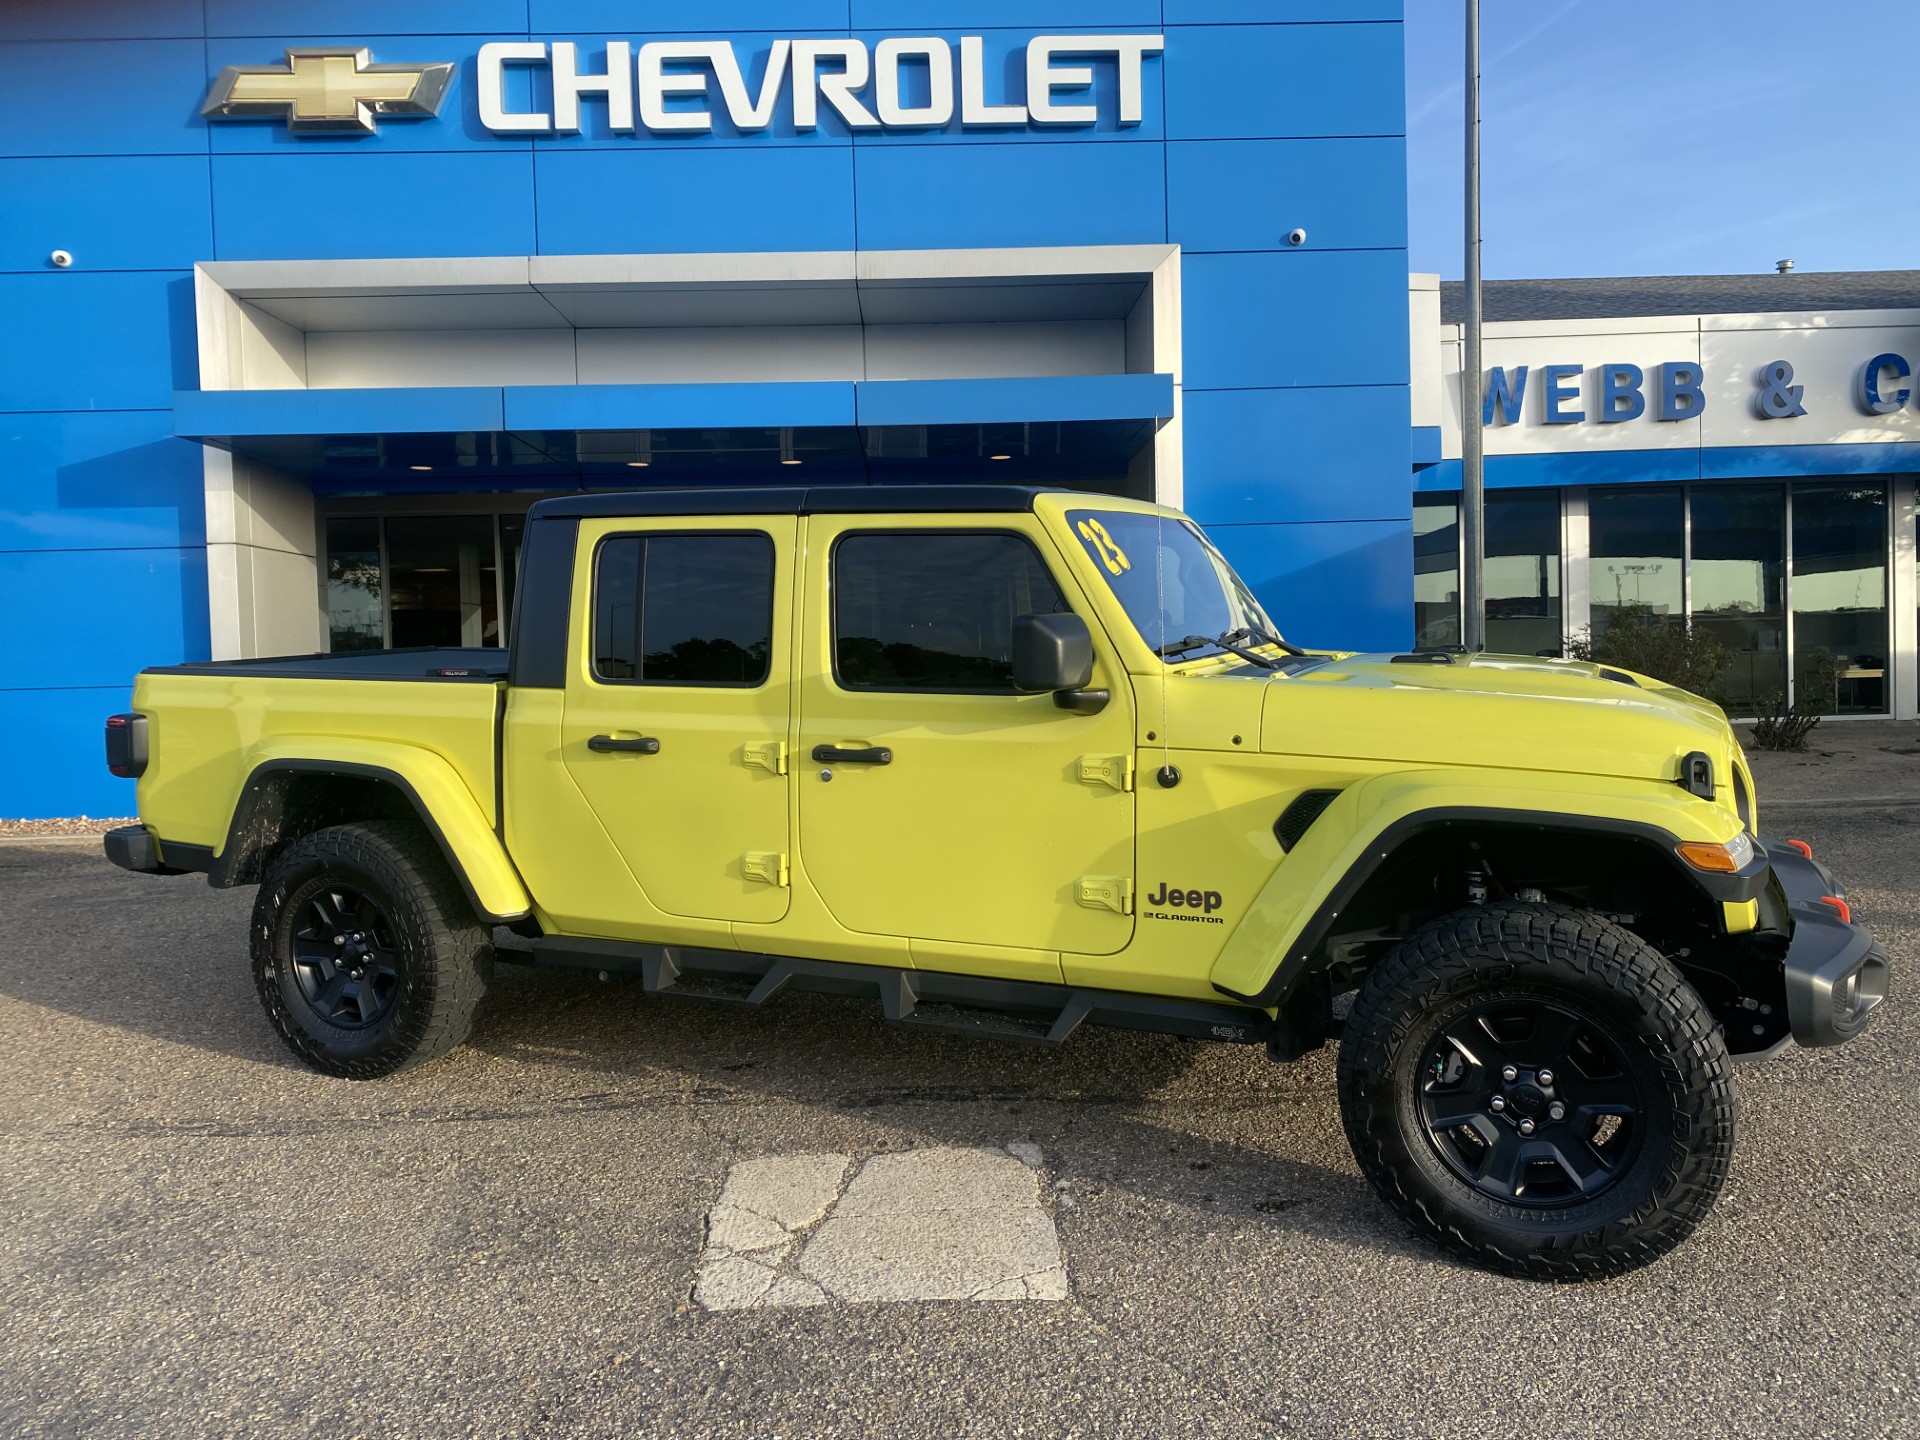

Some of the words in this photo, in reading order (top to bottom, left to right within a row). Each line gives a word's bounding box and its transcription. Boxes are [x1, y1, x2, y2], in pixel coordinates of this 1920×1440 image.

[477, 34, 1164, 134] CHEVROLET
[1482, 361, 1706, 425] WEBB
[1757, 360, 1809, 419] &
[1861, 352, 1920, 415] C
[1078, 518, 1131, 576] 23
[1148, 882, 1222, 914] Jeep
[1155, 912, 1224, 924] GLADIATOR
